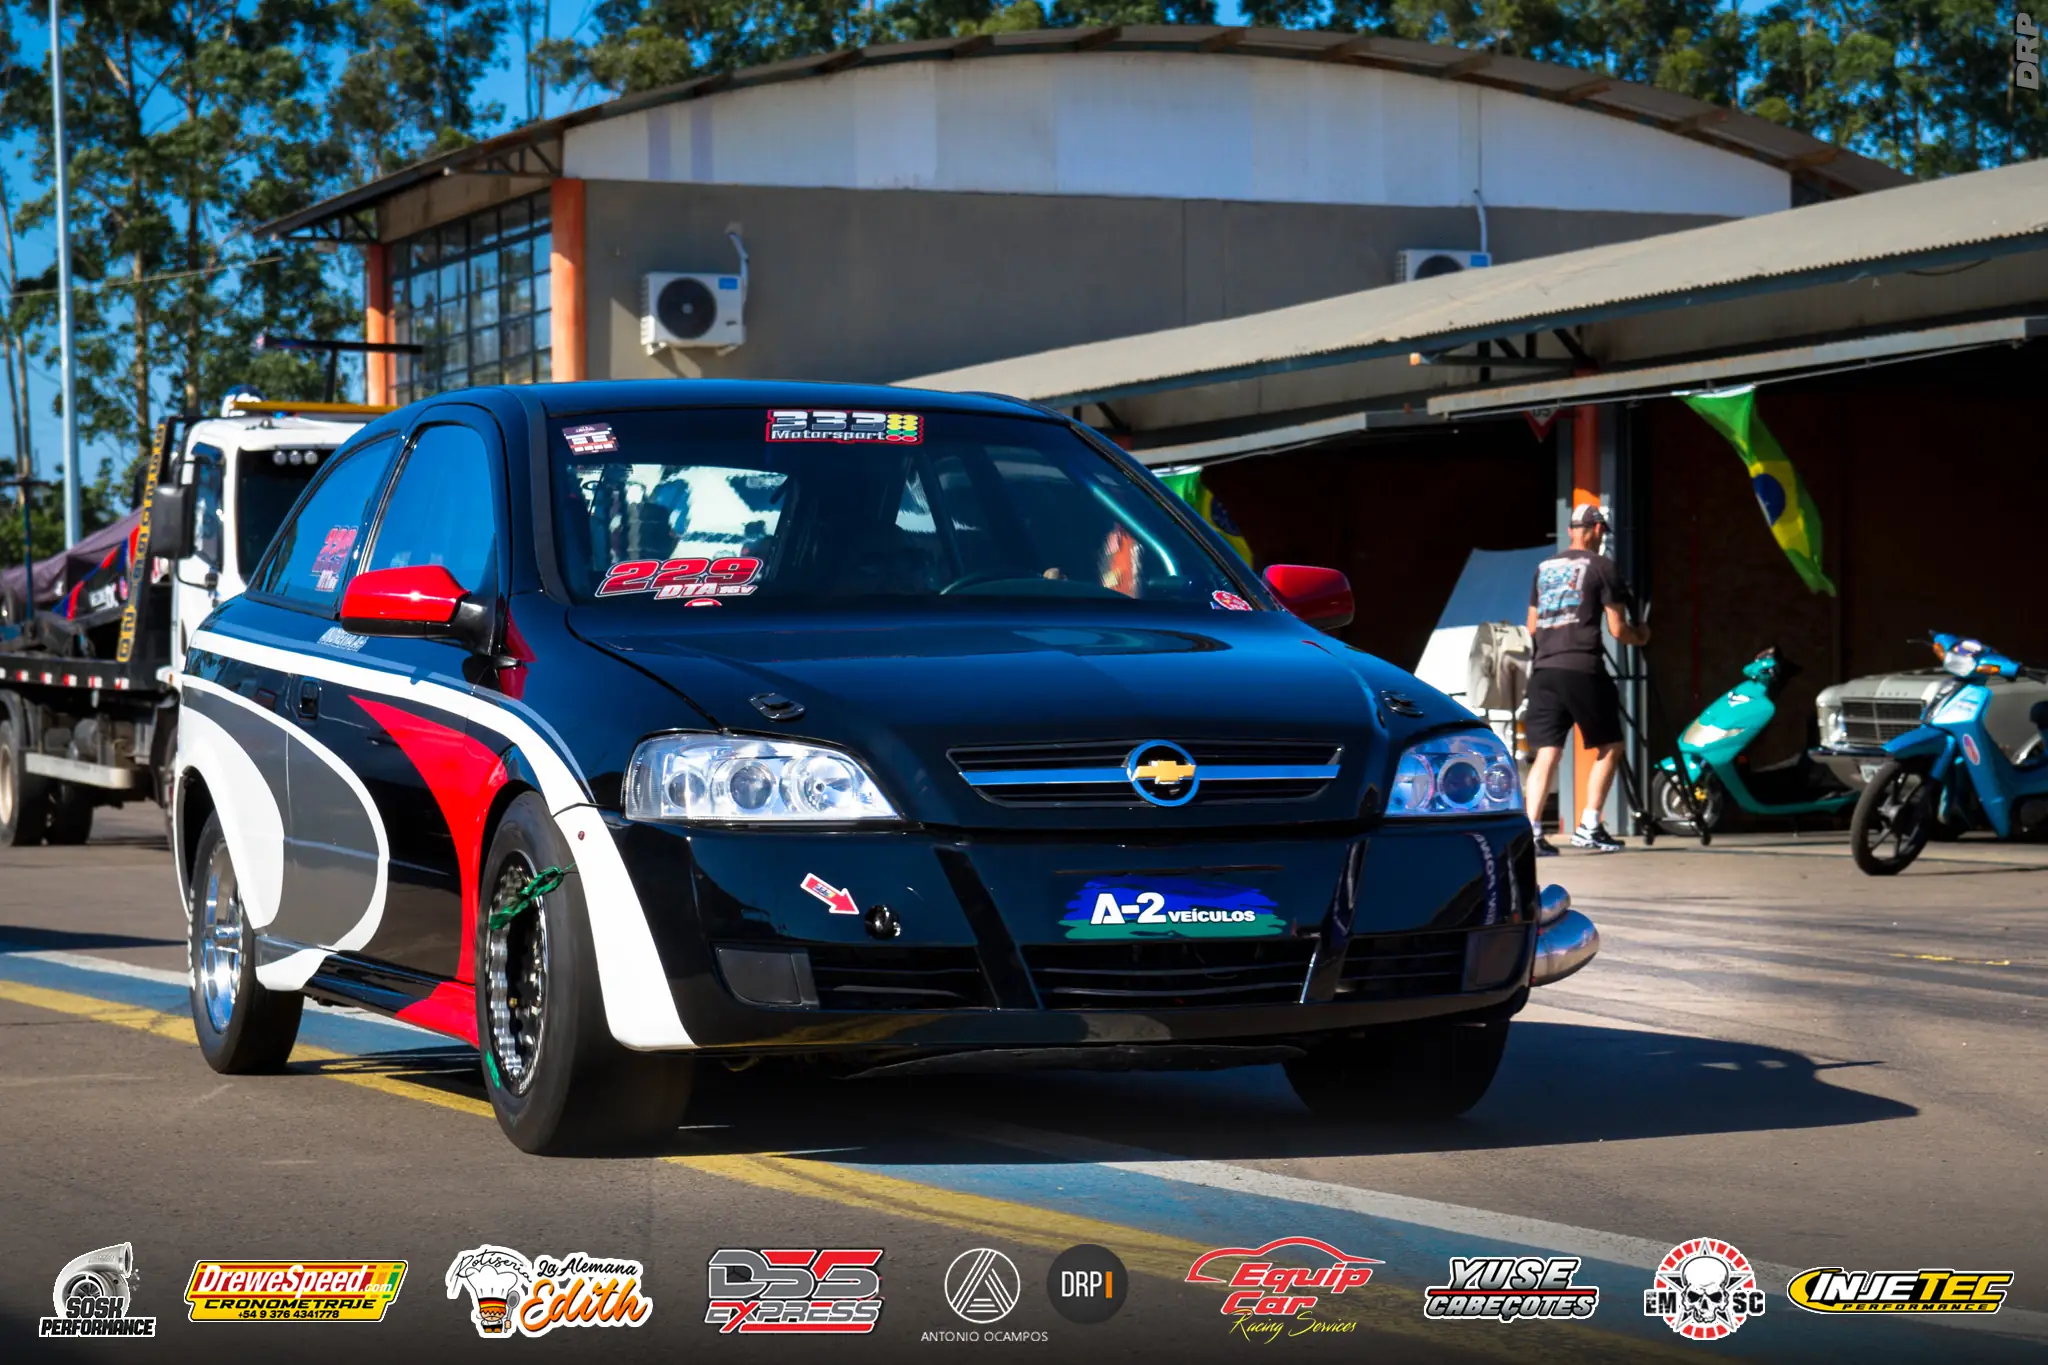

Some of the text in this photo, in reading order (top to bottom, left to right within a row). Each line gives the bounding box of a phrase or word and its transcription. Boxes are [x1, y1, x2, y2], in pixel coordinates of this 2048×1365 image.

[772, 411, 887, 431] 333
[771, 430, 886, 441] Motorsport
[598, 557, 760, 596] 229
[658, 583, 708, 599] DTA
[1090, 892, 1256, 925] A-2 VEÍCULOS
